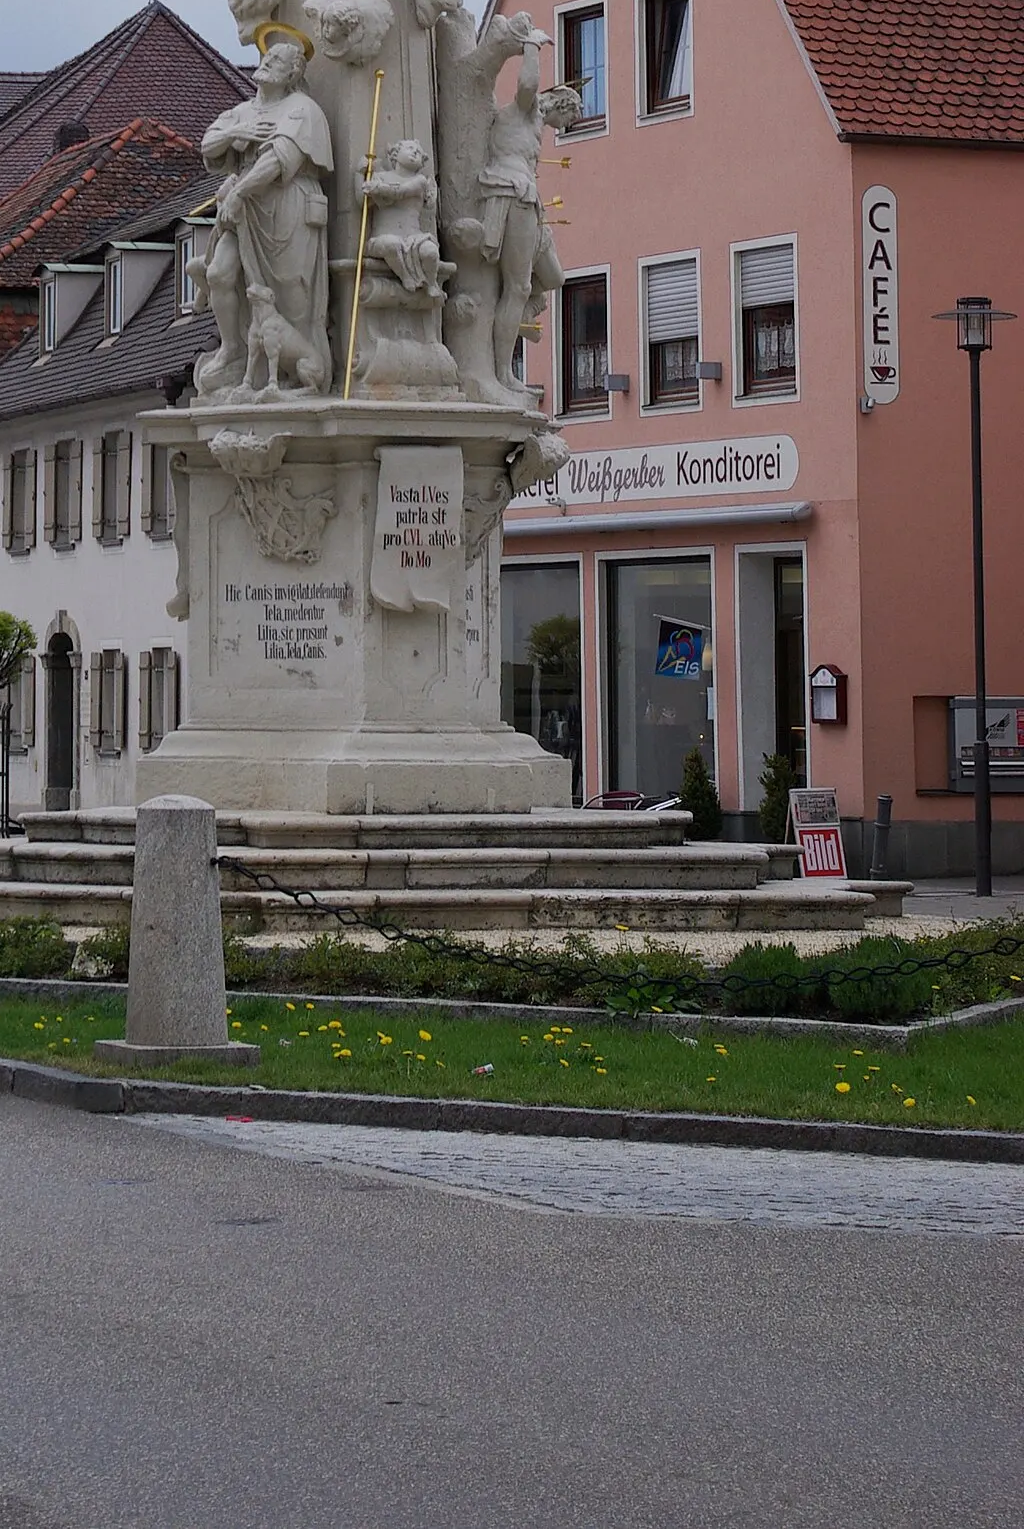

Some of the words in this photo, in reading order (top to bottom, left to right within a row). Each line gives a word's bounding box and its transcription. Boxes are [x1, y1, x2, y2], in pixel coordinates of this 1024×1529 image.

[867, 201, 893, 346] CAFÉ
[567, 453, 666, 503] Weißgerber
[676, 443, 781, 487] Konditorei
[390, 485, 419, 503] Vasta
[225, 583, 242, 602] Hic
[245, 583, 273, 601] Canis
[673, 660, 699, 676] EIS
[802, 833, 841, 871] Bild
